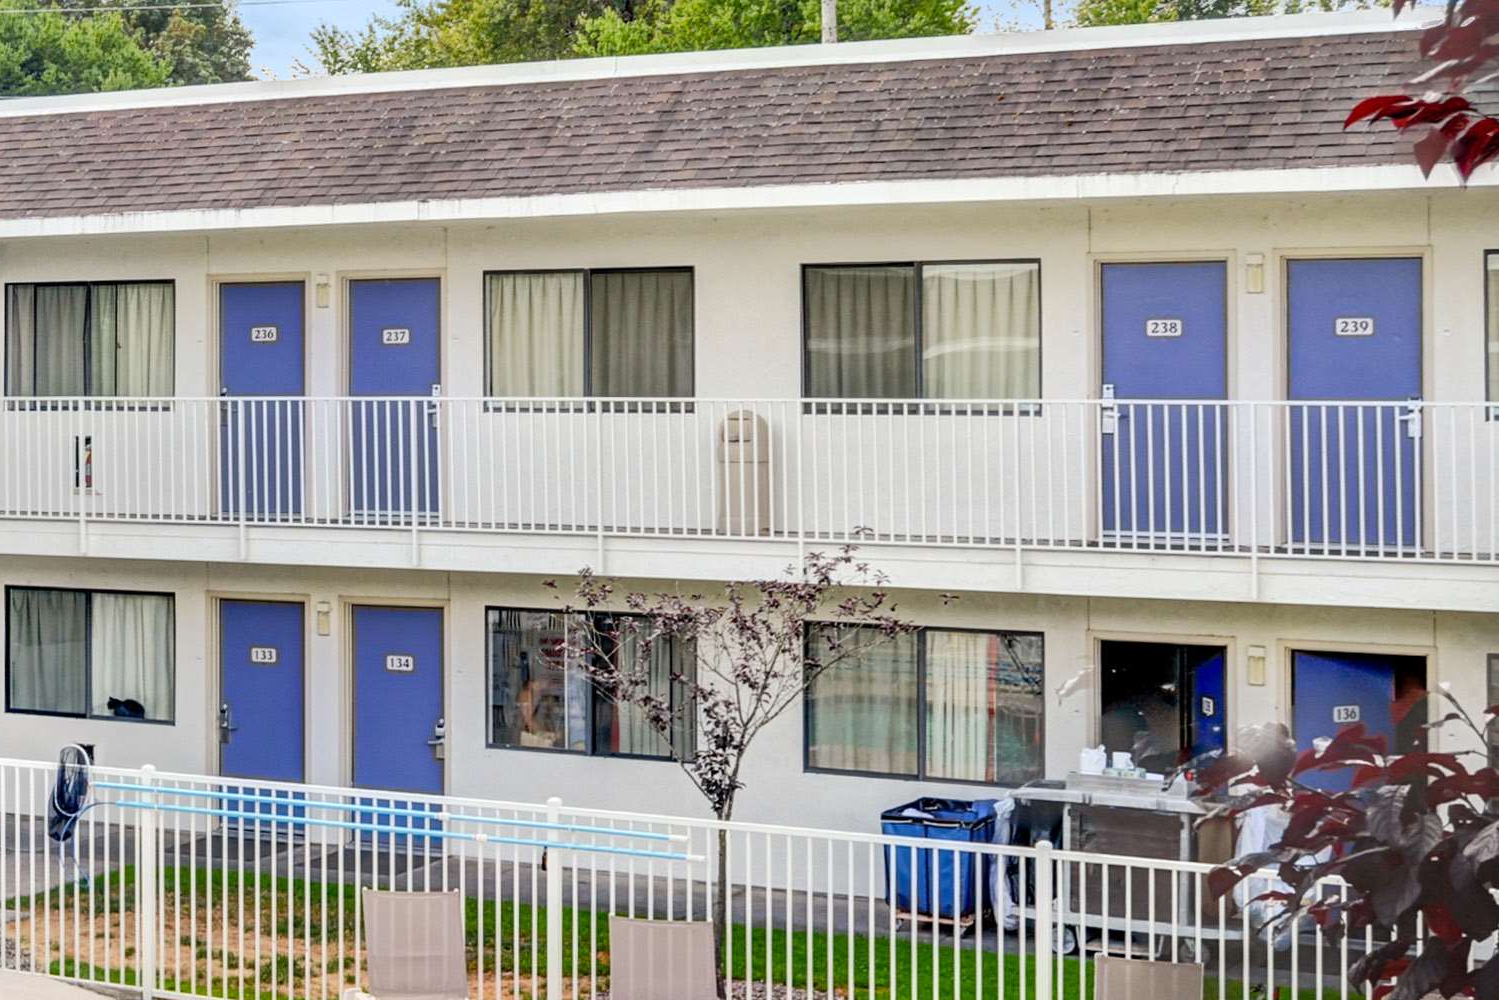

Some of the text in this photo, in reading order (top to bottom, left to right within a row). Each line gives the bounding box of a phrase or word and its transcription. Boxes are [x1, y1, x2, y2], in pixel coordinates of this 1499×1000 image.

[1151, 322, 1178, 333] 238
[1340, 320, 1368, 333] 239
[254, 329, 274, 340] 236
[385, 331, 406, 342] 237
[254, 650, 273, 661] 133
[389, 657, 410, 668] 134
[1337, 708, 1357, 720] 136
